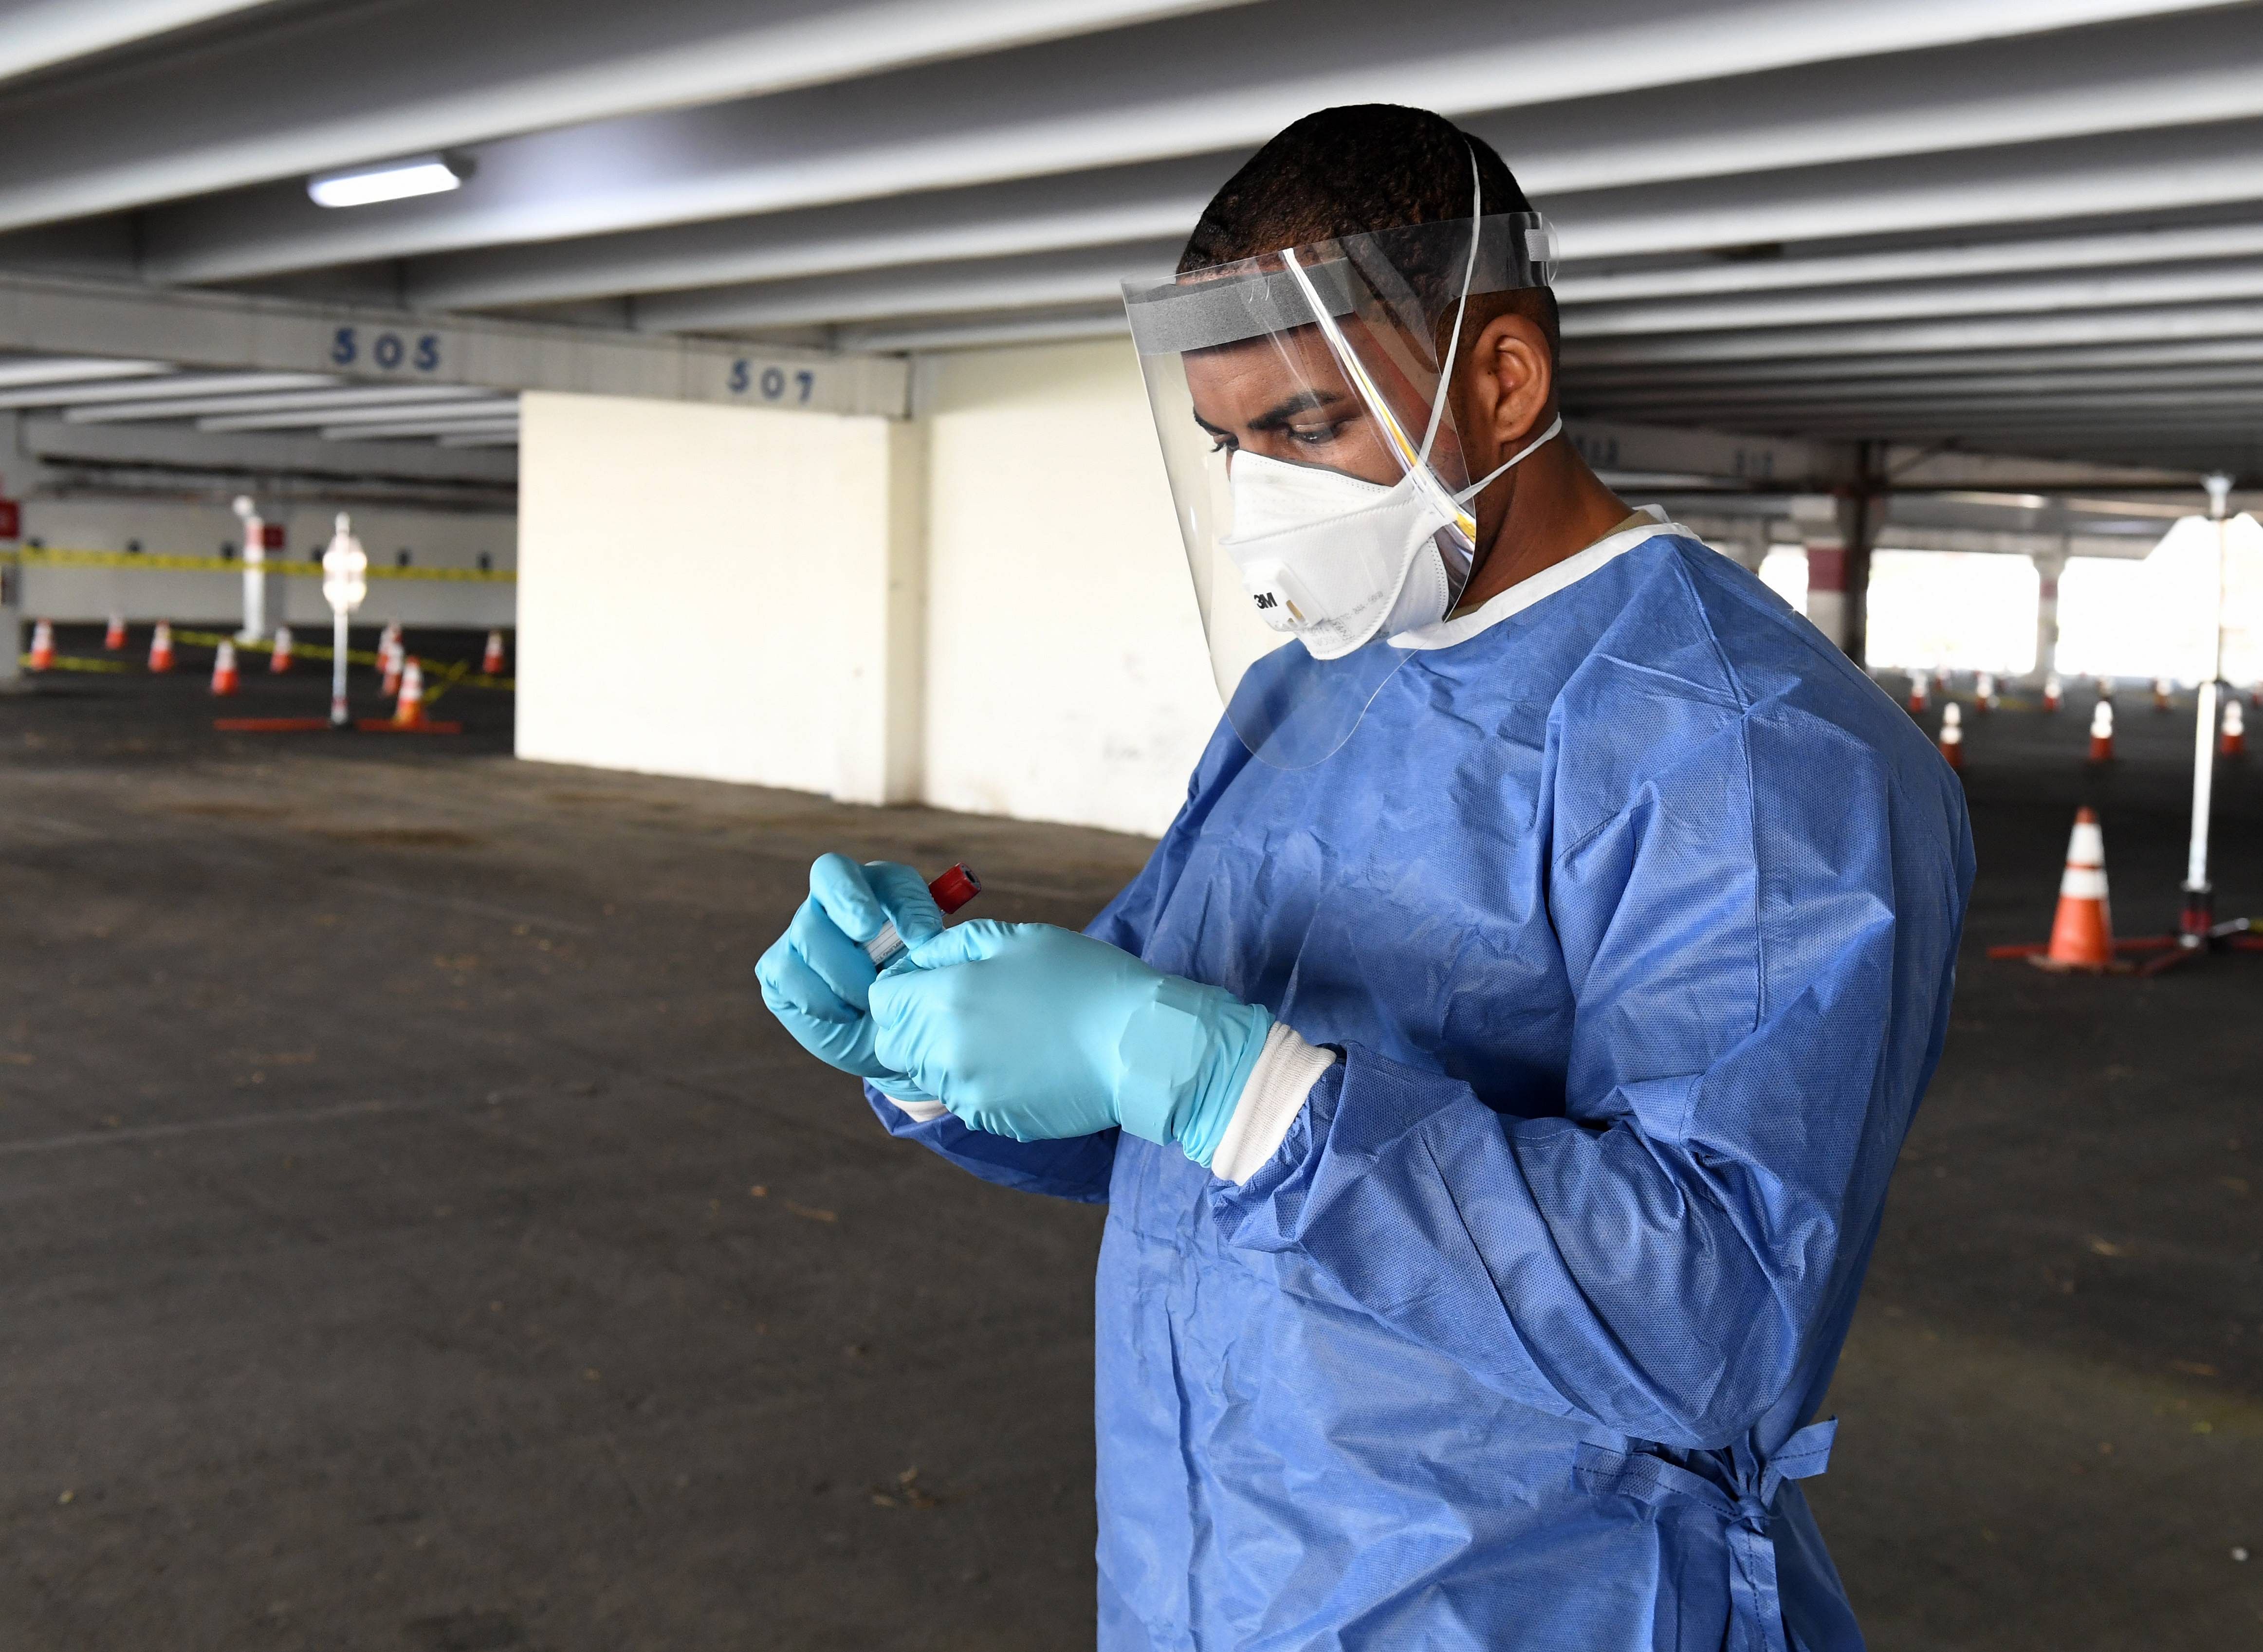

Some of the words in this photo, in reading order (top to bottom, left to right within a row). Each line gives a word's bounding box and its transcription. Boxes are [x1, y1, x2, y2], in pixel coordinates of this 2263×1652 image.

[331, 327, 441, 371] 505
[727, 359, 814, 404] 507
[1253, 592, 1278, 609] 3M
